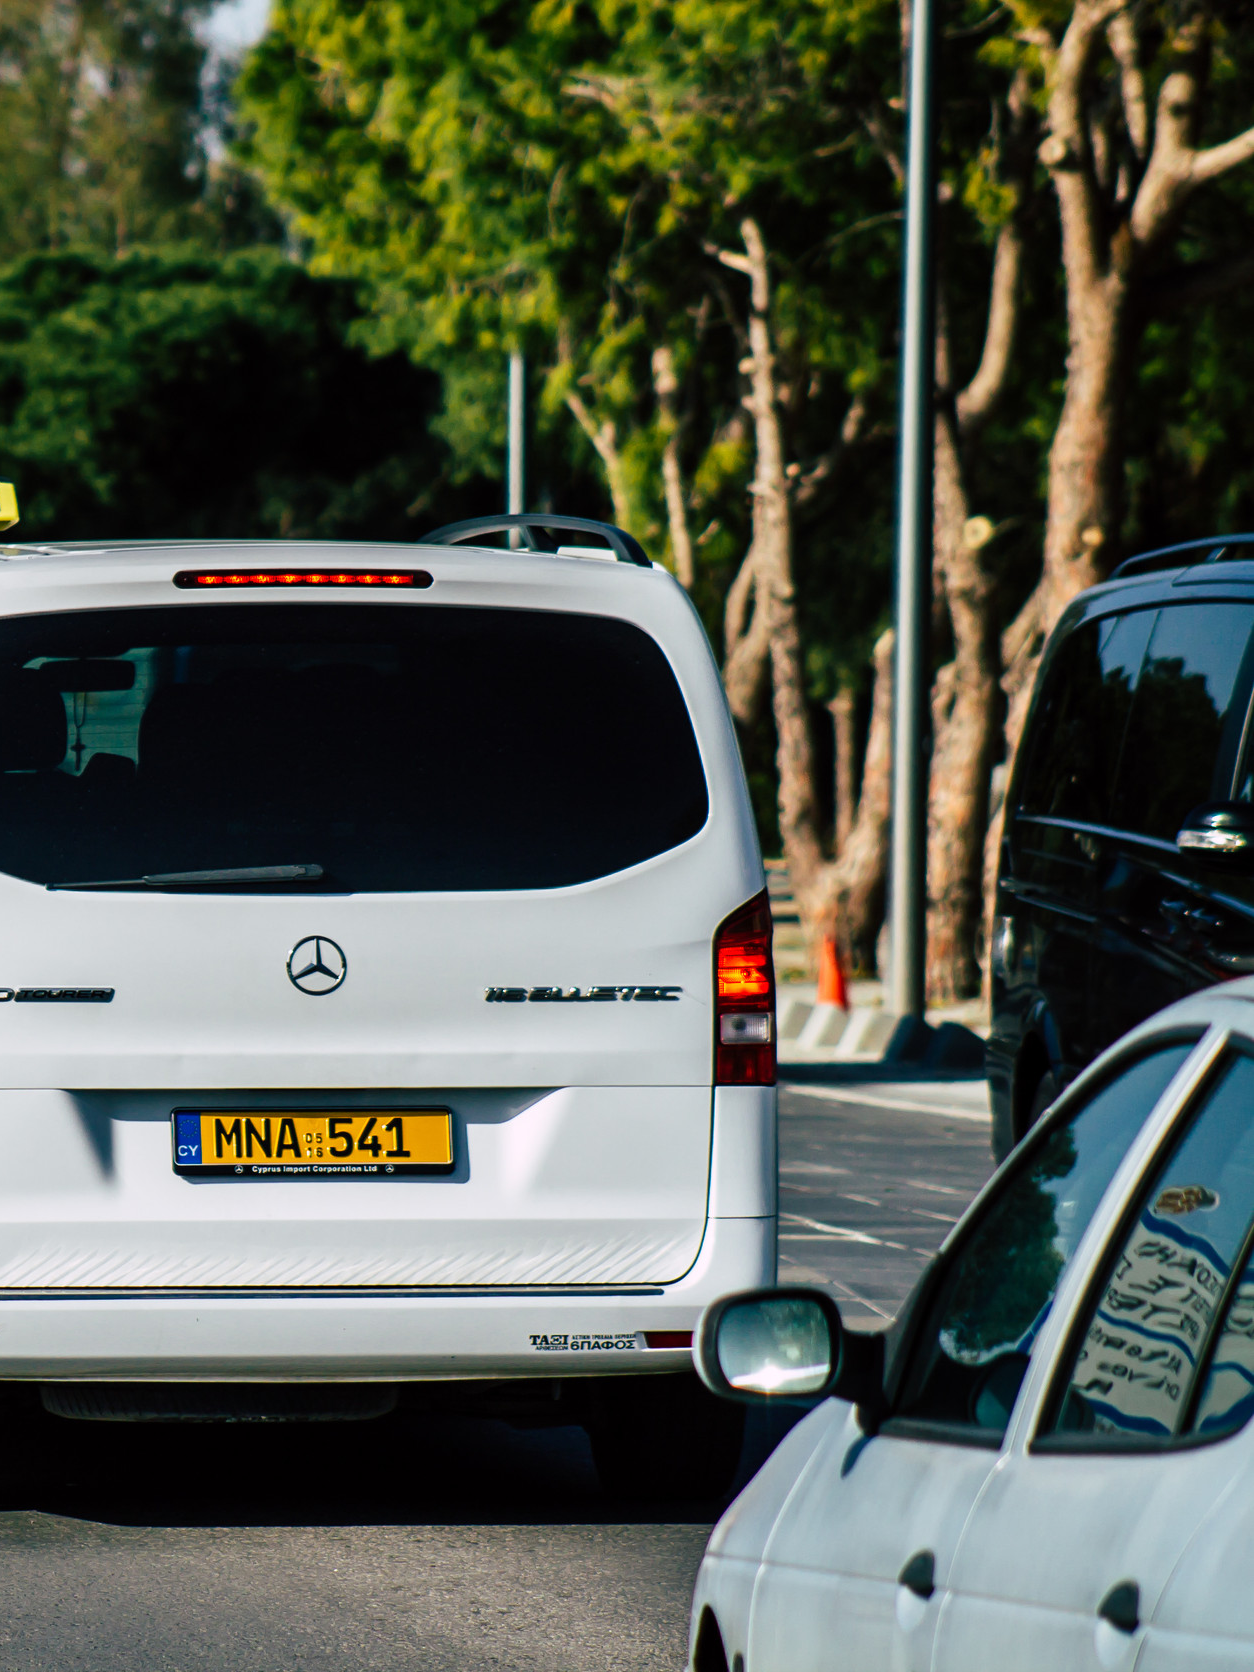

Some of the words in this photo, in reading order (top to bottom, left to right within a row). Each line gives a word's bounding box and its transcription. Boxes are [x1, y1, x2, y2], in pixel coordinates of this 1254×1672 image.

[16, 988, 113, 1002] TOURER
[213, 1117, 302, 1159] MNA
[326, 1117, 411, 1158] 541
[305, 1132, 323, 1144] 05
[177, 1145, 199, 1157] CY
[251, 1165, 282, 1174] Cyprus
[283, 1165, 311, 1174] Import
[312, 1165, 362, 1174] Corporation
[363, 1165, 378, 1173] Ltd
